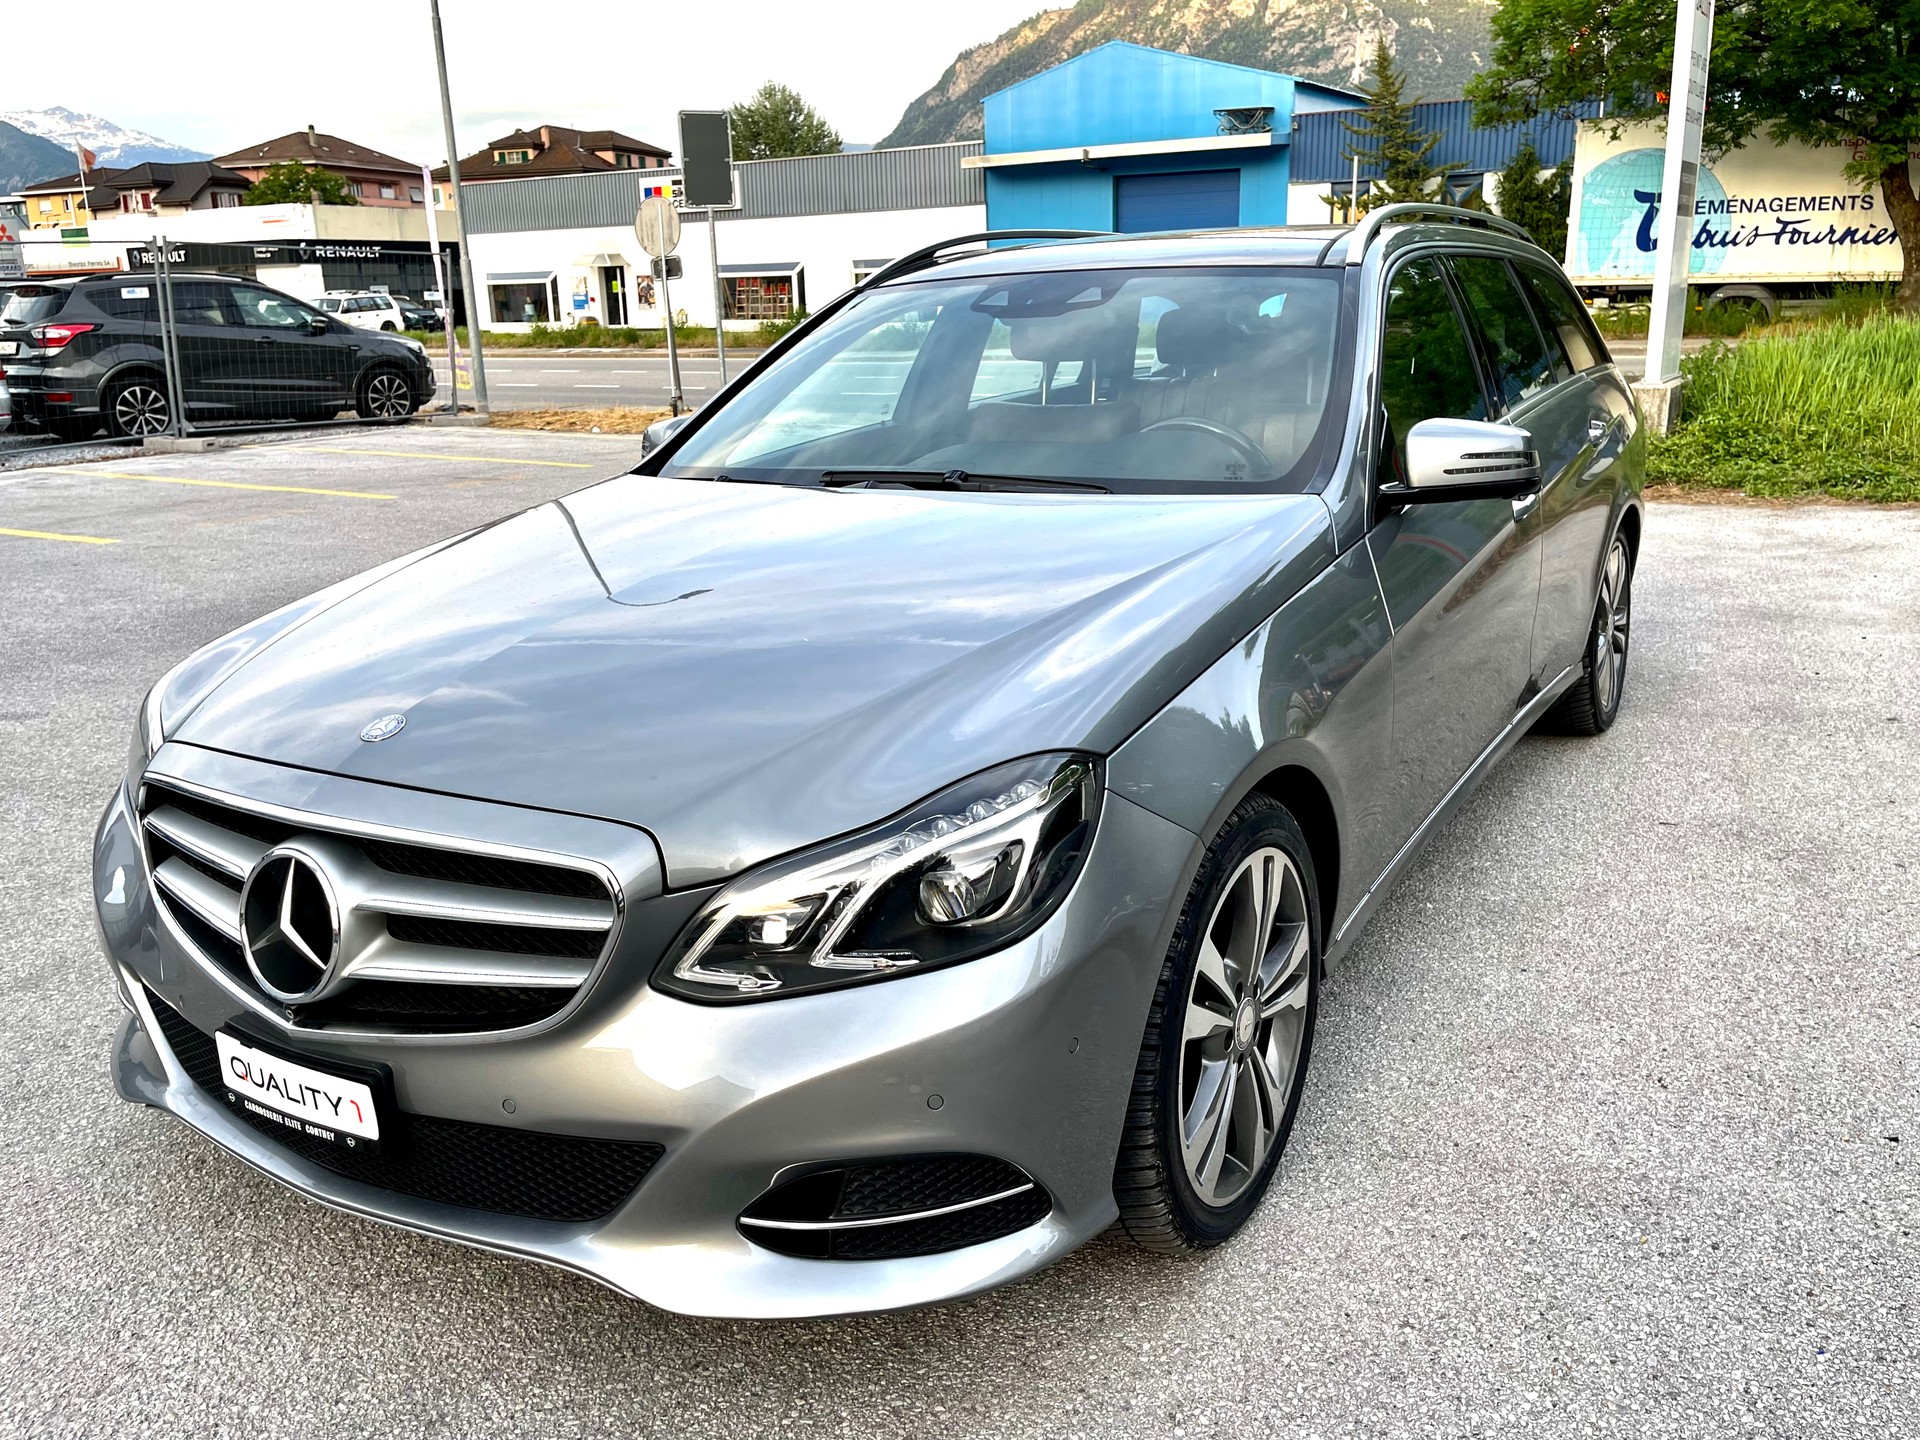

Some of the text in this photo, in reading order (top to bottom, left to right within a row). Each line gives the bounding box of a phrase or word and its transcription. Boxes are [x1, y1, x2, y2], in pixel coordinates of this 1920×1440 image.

[1695, 195, 1874, 214] ÉMÉNAGEMENTS
[315, 245, 381, 258] RENAULT
[230, 1055, 343, 1117] QUALITY
[244, 1100, 284, 1124] CARROSSERIE
[284, 1116, 302, 1131] ELITE
